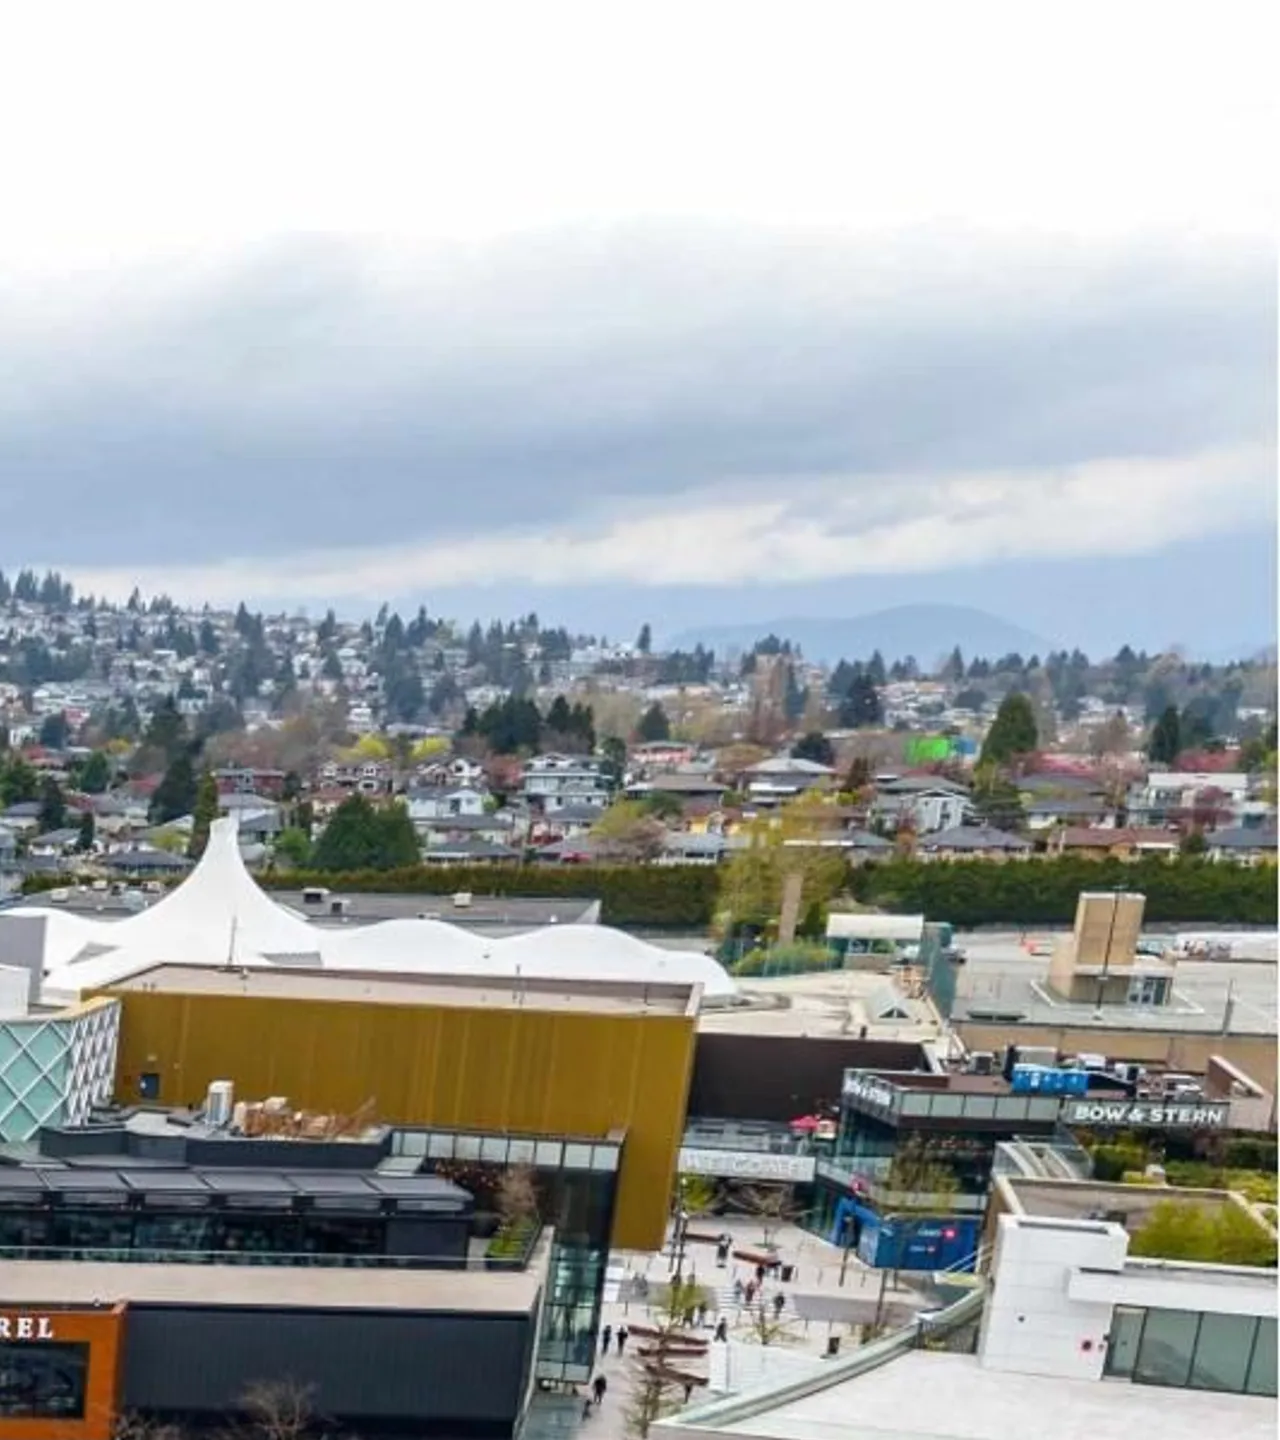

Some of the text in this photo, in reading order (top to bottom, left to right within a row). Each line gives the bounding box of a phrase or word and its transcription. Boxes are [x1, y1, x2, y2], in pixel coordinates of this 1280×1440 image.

[1073, 1105, 1224, 1123] BOW & STERN
